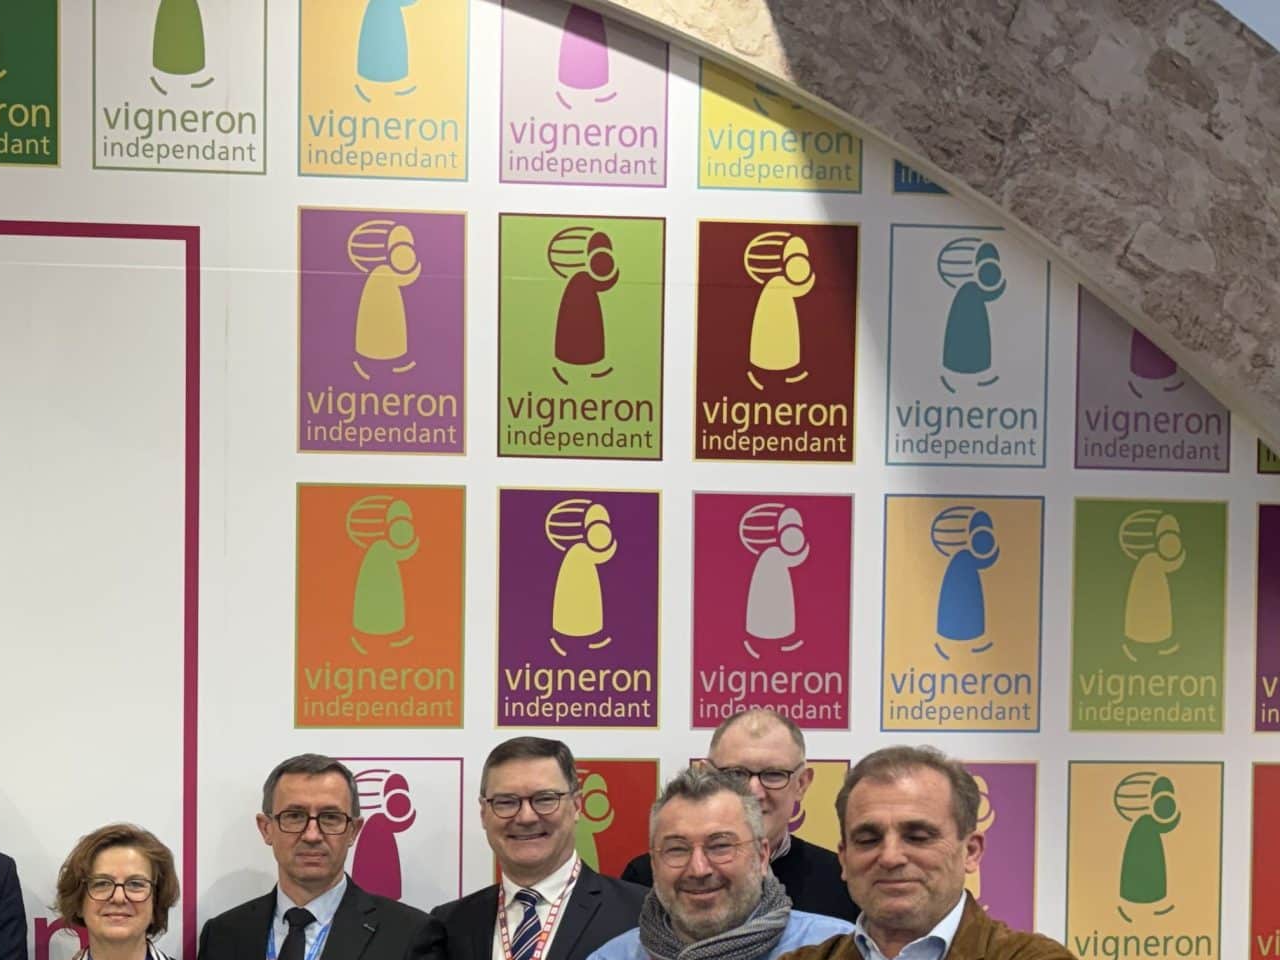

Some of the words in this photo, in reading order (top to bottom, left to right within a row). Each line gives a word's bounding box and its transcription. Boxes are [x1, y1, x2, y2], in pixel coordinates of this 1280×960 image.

[103, 102, 255, 139] vigneron
[308, 110, 458, 147] vigneron
[511, 117, 657, 153] vigneron
[104, 136, 255, 164] independant
[307, 143, 458, 171] independant
[708, 124, 854, 159] vigneron
[508, 149, 658, 177] independant
[706, 156, 854, 184] independant
[308, 385, 456, 423] vigneron
[508, 392, 653, 428] vigneron
[703, 397, 847, 433] vigneron
[896, 400, 1037, 436] vigneron
[308, 421, 456, 448] independant
[508, 425, 652, 451] independant
[1085, 403, 1221, 440] vigneron
[703, 430, 846, 456] independant
[895, 432, 1036, 459] independant
[1084, 436, 1221, 463] independant
[305, 664, 455, 698] vigneron
[505, 664, 651, 699] vigneron
[700, 666, 843, 701] vigneron
[890, 668, 1032, 702] vigneron
[1079, 669, 1217, 702] vigneron
[304, 695, 455, 721] independant
[506, 696, 650, 722] independant
[889, 698, 1031, 724] independant
[1078, 699, 1217, 726] independant
